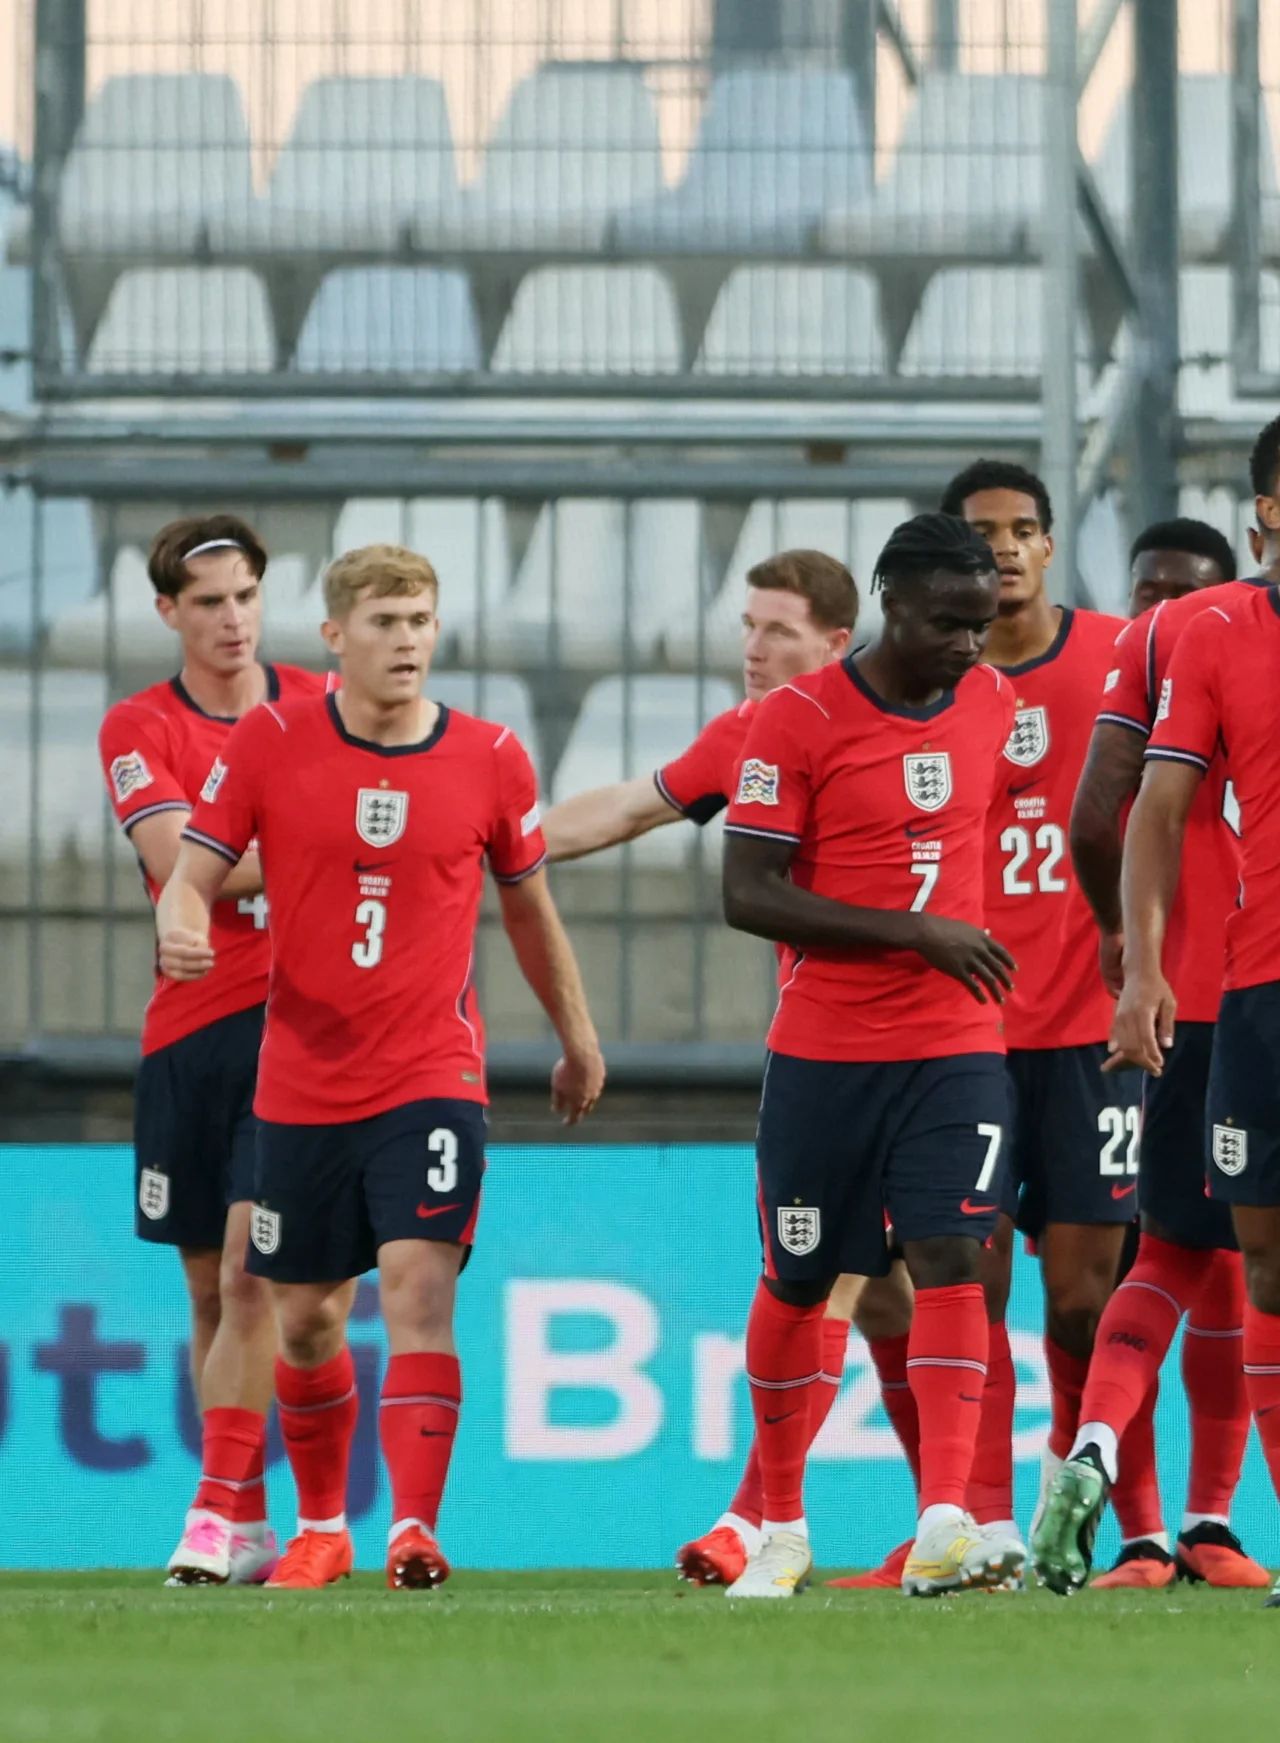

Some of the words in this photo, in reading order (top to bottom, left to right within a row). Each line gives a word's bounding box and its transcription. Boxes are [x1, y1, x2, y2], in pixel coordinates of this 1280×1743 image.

[1014, 796, 1046, 810] CROATIA
[909, 863, 940, 912] 7
[1000, 823, 1066, 894] 22
[350, 899, 387, 968] 3
[427, 1127, 459, 1193] 3
[974, 1123, 1002, 1192] 7
[1098, 1105, 1140, 1176] 22
